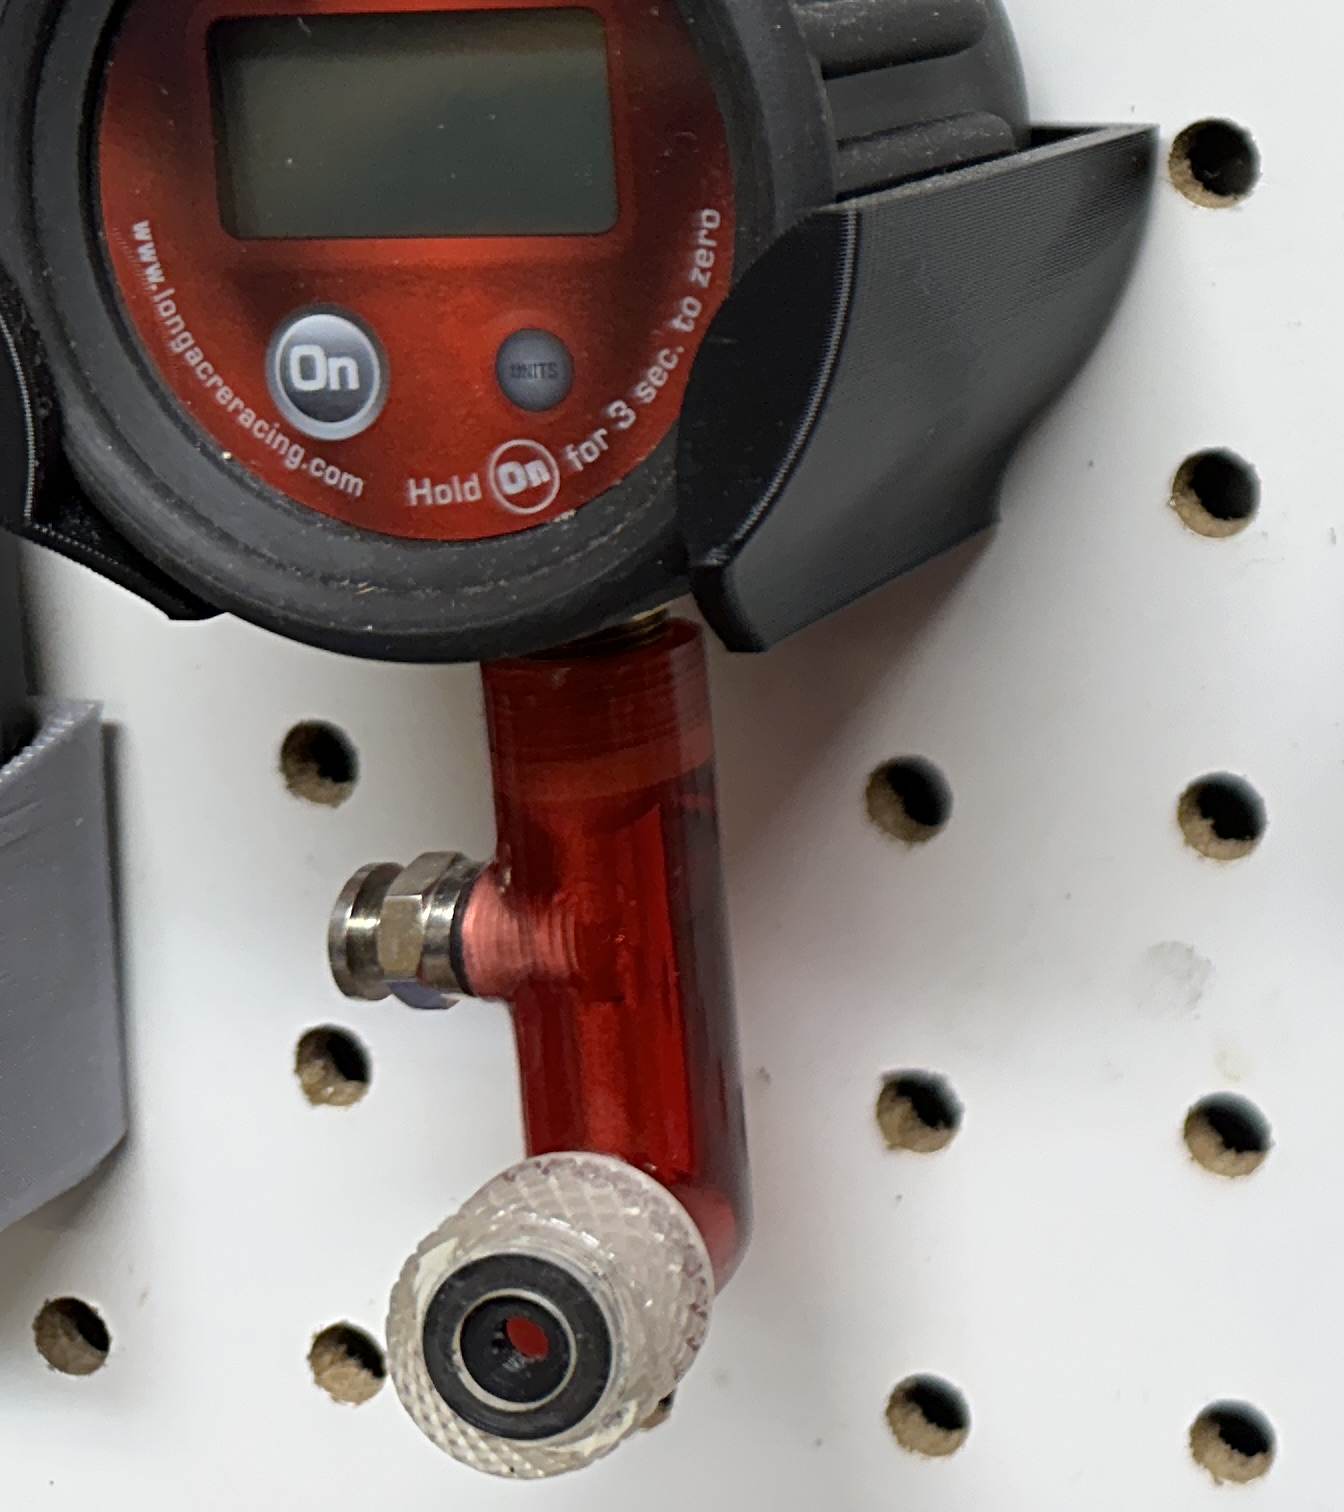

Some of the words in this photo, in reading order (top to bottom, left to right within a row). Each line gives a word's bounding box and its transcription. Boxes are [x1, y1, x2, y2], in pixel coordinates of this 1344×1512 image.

[131, 219, 366, 498] www.longacreracing.com
[289, 344, 360, 391] On
[405, 473, 483, 508] Hold
[499, 459, 551, 496] On
[565, 428, 609, 472] for
[605, 399, 637, 430] 3
[630, 345, 686, 405] sec.
[668, 295, 703, 334] to
[687, 208, 722, 288] zero
[510, 362, 559, 380] UNITS
